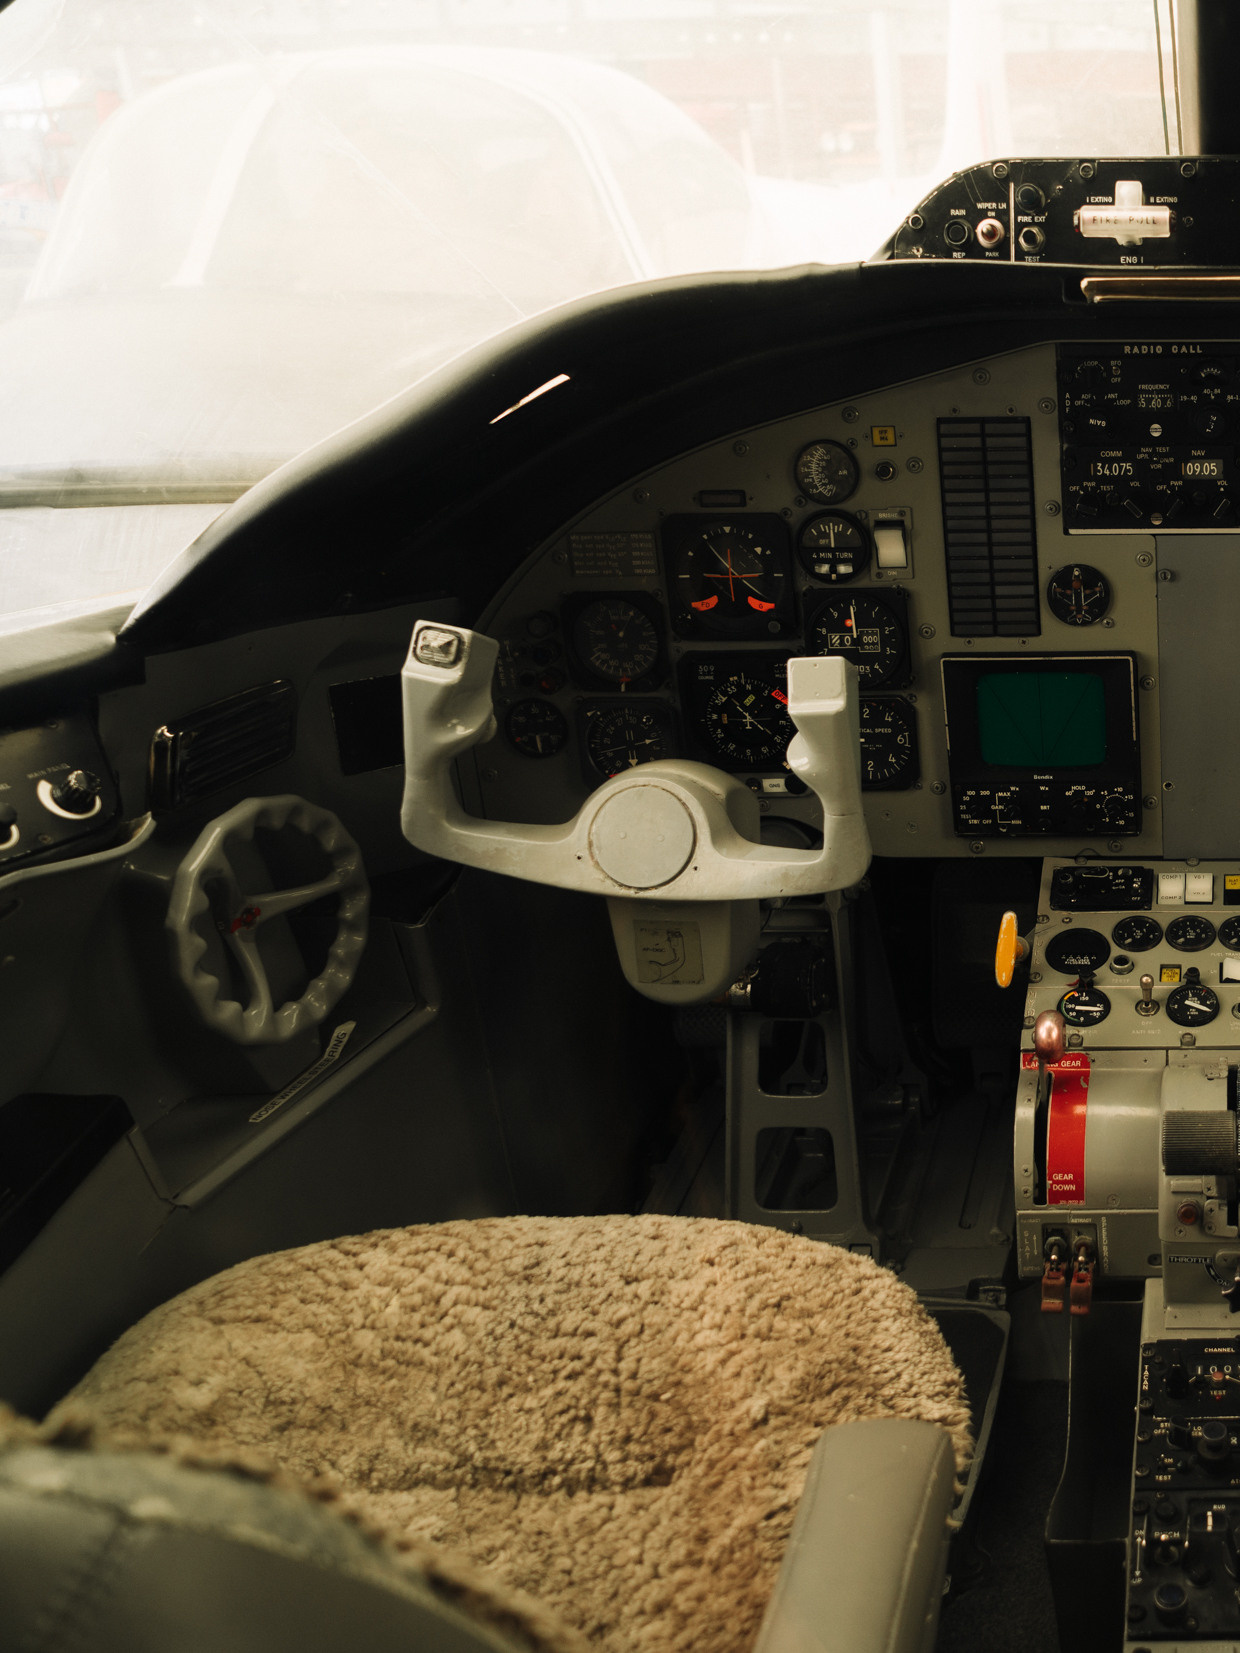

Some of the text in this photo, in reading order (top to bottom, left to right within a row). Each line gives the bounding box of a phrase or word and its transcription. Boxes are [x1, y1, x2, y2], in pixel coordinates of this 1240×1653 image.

[976, 202, 994, 210] WIPER
[1017, 215, 1047, 223] FIRE EXT
[952, 251, 966, 259] REP
[1024, 255, 1040, 263] TEST
[1120, 256, 1138, 264] ENG
[1123, 345, 1203, 354] RADIO CALL
[1100, 450, 1123, 458] COMM
[252, 1100, 279, 1121] NOSE
[308, 1031, 347, 1076] STEERING
[1052, 1173, 1074, 1181] GEAR
